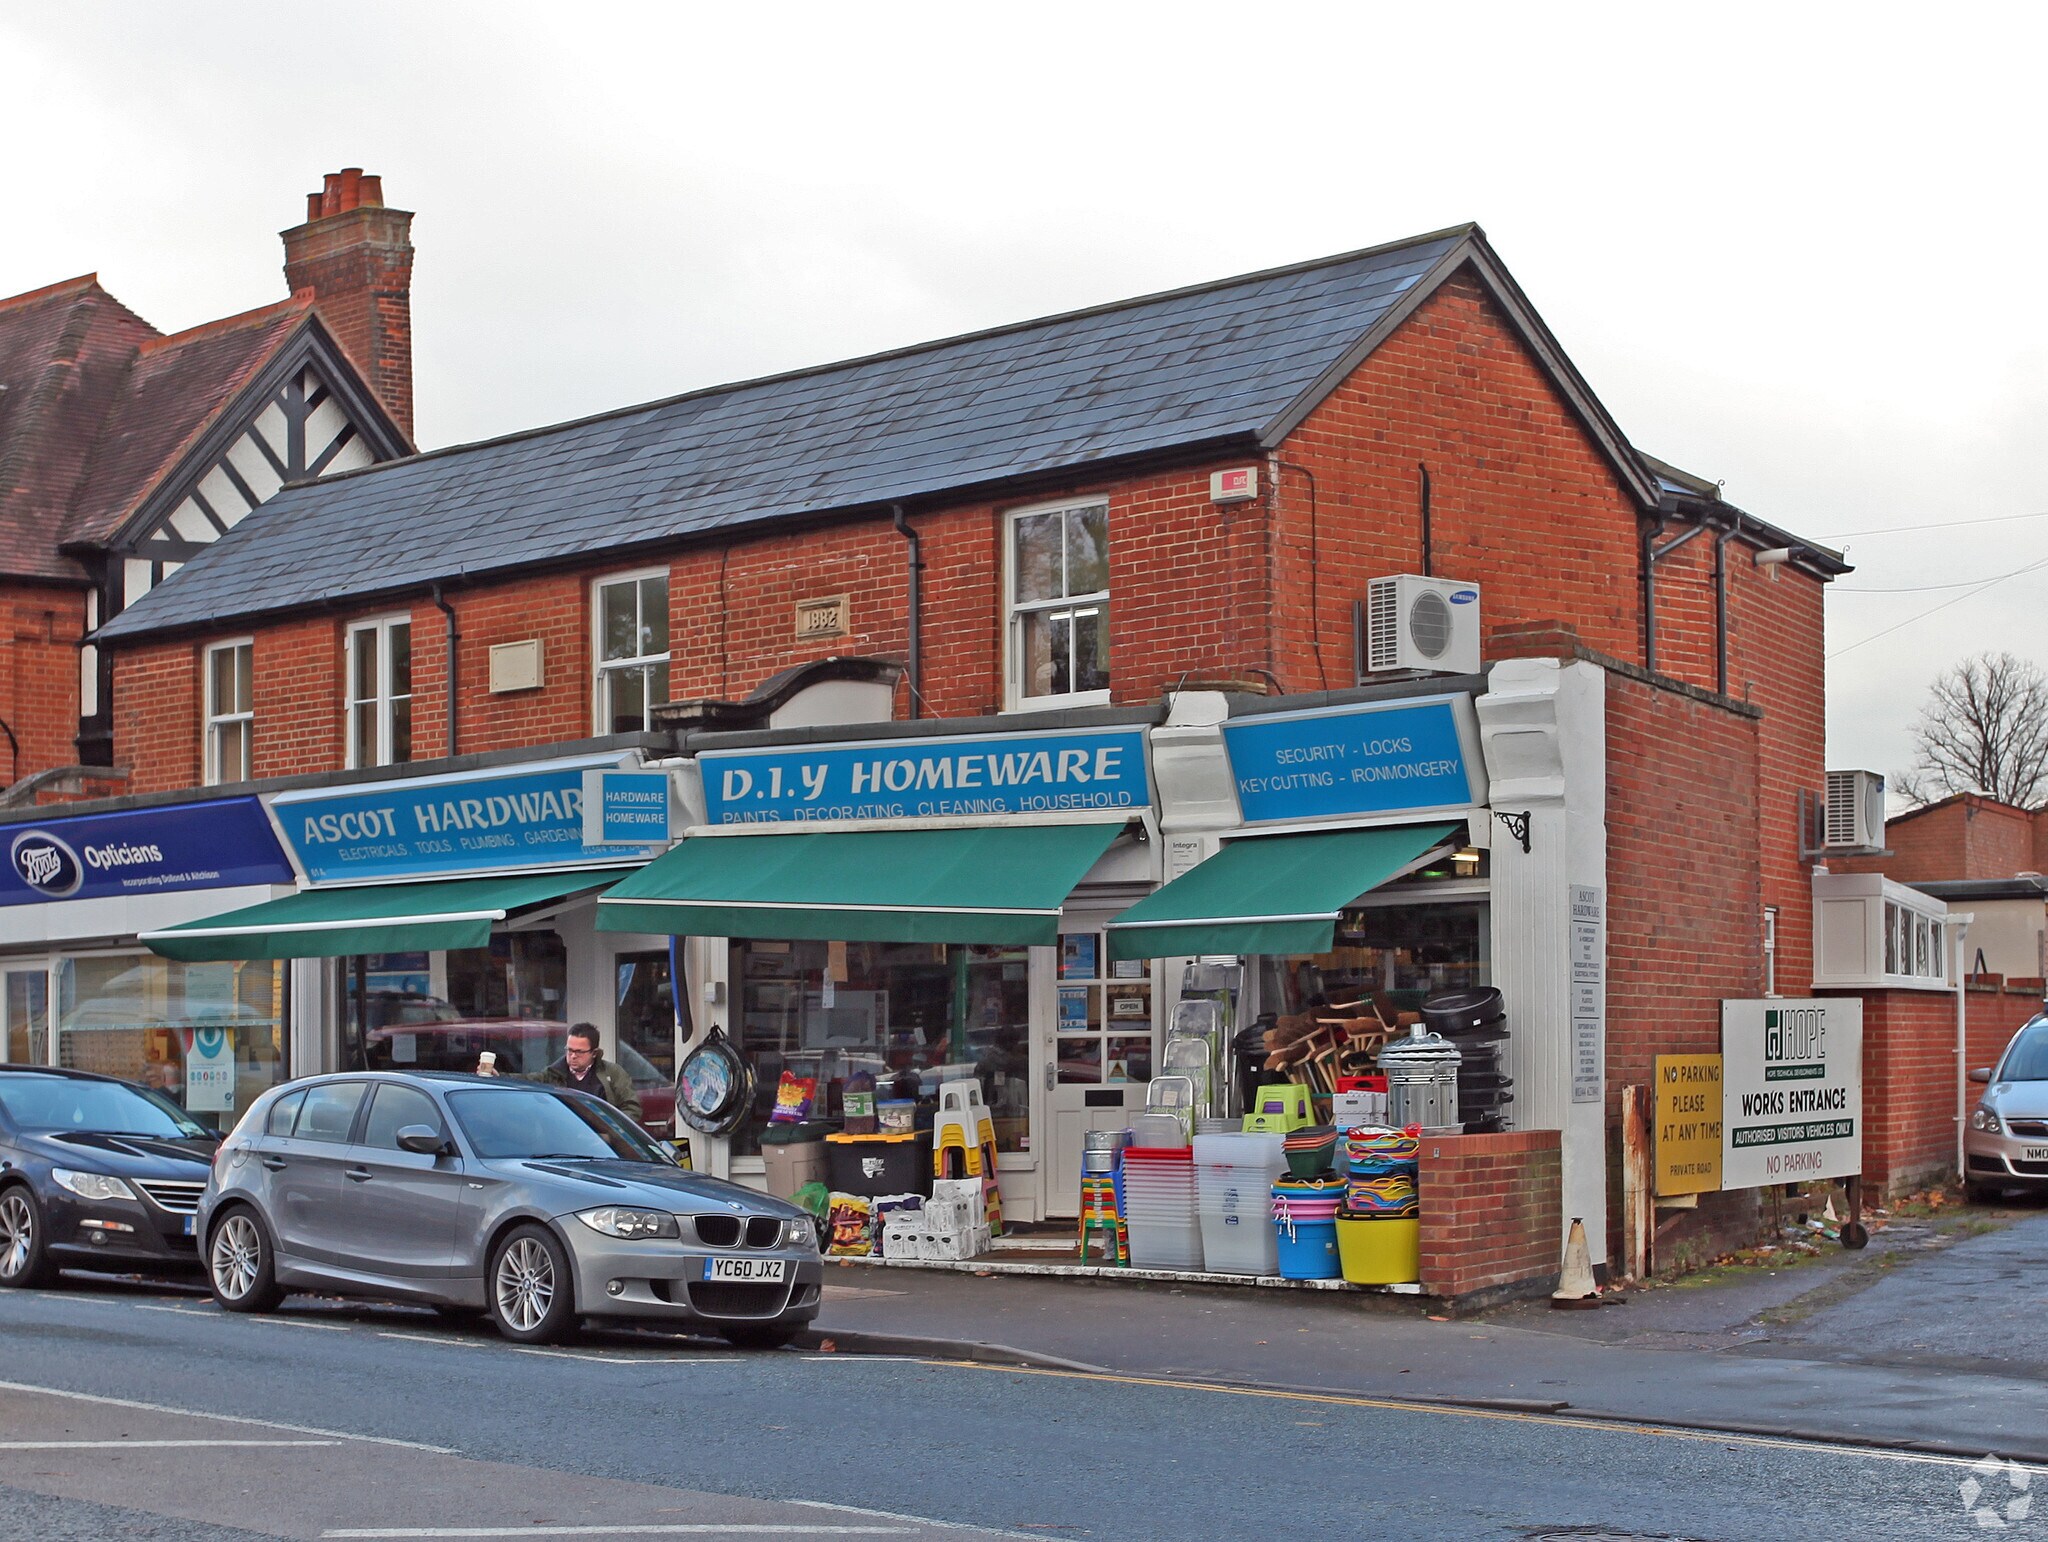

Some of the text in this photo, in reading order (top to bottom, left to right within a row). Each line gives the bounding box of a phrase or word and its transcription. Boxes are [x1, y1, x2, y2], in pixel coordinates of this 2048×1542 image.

[808, 607, 838, 630] 1882
[1275, 744, 1346, 765] SECURITY
[1362, 737, 1412, 756] LOCKS
[851, 747, 1123, 794] HOMEWARE
[1240, 778, 1268, 793] KEY
[1271, 772, 1333, 791] CUTTING
[1351, 760, 1458, 783] IRONMONGERY
[605, 792, 664, 803] HARDWARE
[1020, 791, 1131, 810] HOUSEHOLD
[304, 788, 583, 844] ASCOT HARDWAR
[605, 813, 665, 823] HOMEWARE
[524, 828, 583, 844] GARDENIN
[20, 846, 62, 884] Boots
[84, 842, 163, 870] Opticians
[1579, 891, 1595, 903] ASCOT
[1572, 904, 1600, 918] HARDWARE
[1783, 1009, 1825, 1060] HOPE
[1663, 1065, 1719, 1083] NO PARKING
[1672, 1094, 1705, 1113] PLEASE
[1741, 1088, 1846, 1117] WORKS ENTRANCE
[1662, 1122, 1721, 1142] AT ANY TIME
[1735, 1122, 1851, 1145] AUTHORISED VISITORS VEHICLES ONLY
[1670, 1162, 1712, 1176] PRIVATE ROAD
[1766, 1151, 1822, 1174] NO PARKING
[715, 1259, 782, 1278] YC60 JXZ
